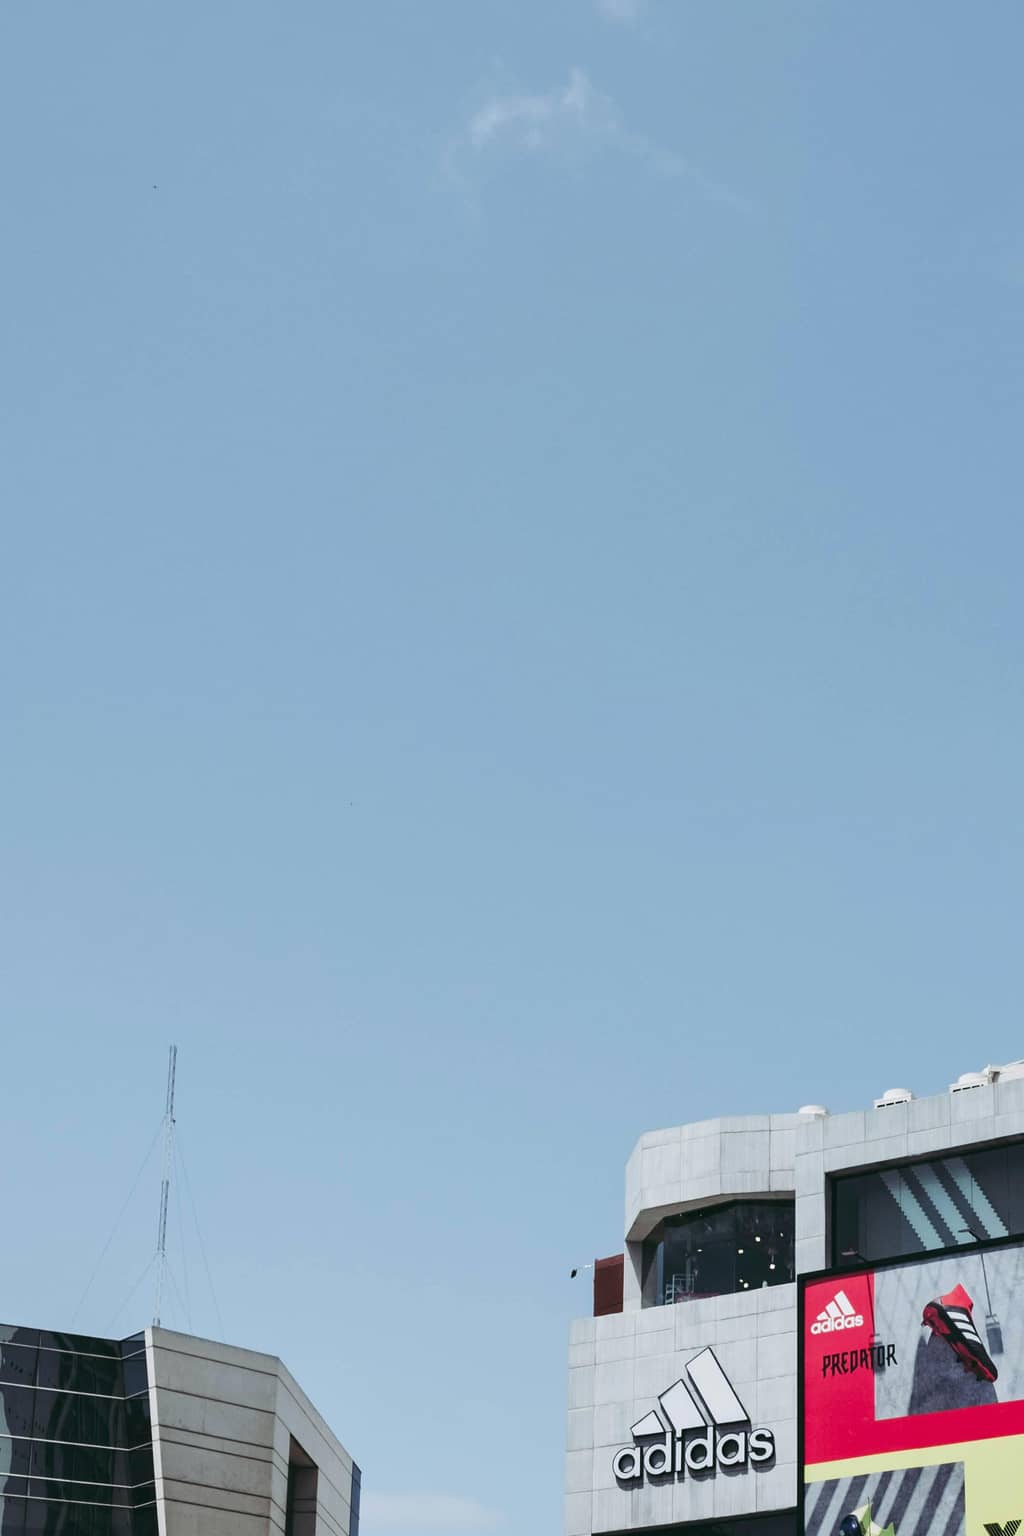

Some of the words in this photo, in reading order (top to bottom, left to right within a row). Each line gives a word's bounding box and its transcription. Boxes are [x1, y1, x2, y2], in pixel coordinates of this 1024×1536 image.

[811, 1315, 864, 1335] adidas
[822, 1344, 898, 1377] PREDATOR
[612, 1425, 775, 1482] adidas
